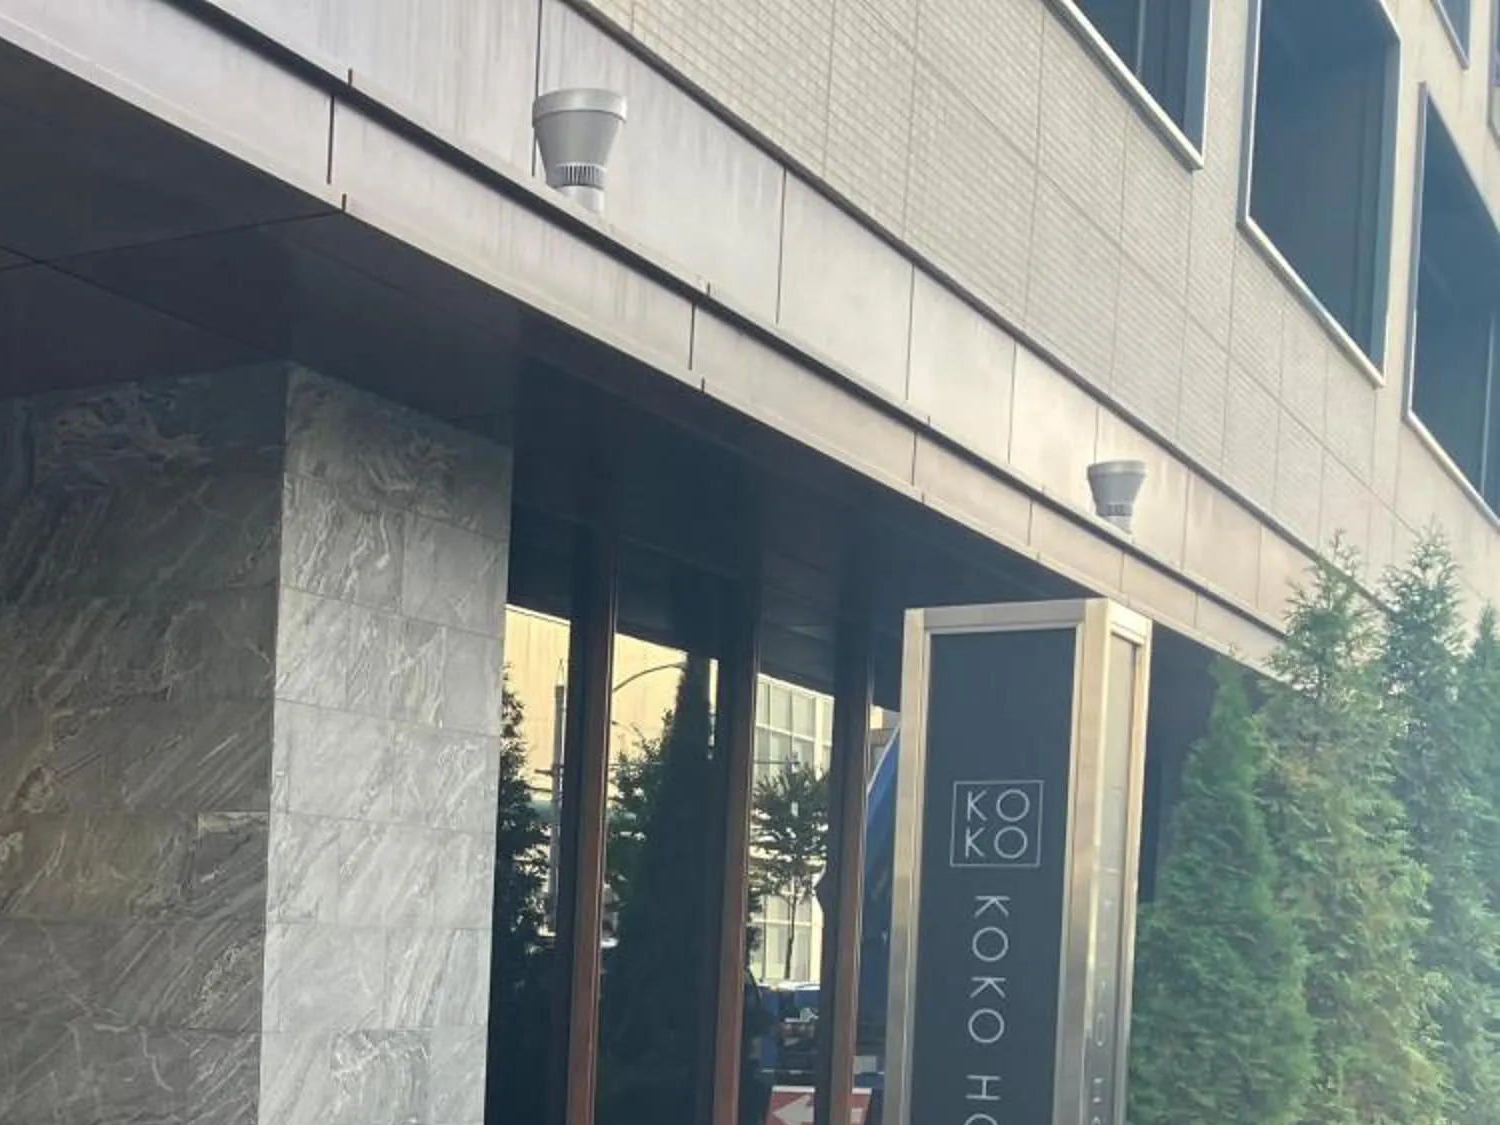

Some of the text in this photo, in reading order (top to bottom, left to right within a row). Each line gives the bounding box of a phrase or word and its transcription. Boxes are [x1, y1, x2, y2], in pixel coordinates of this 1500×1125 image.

[966, 788, 1030, 822] KO
[964, 825, 1028, 859] KO
[968, 895, 1011, 1044] KOKO
